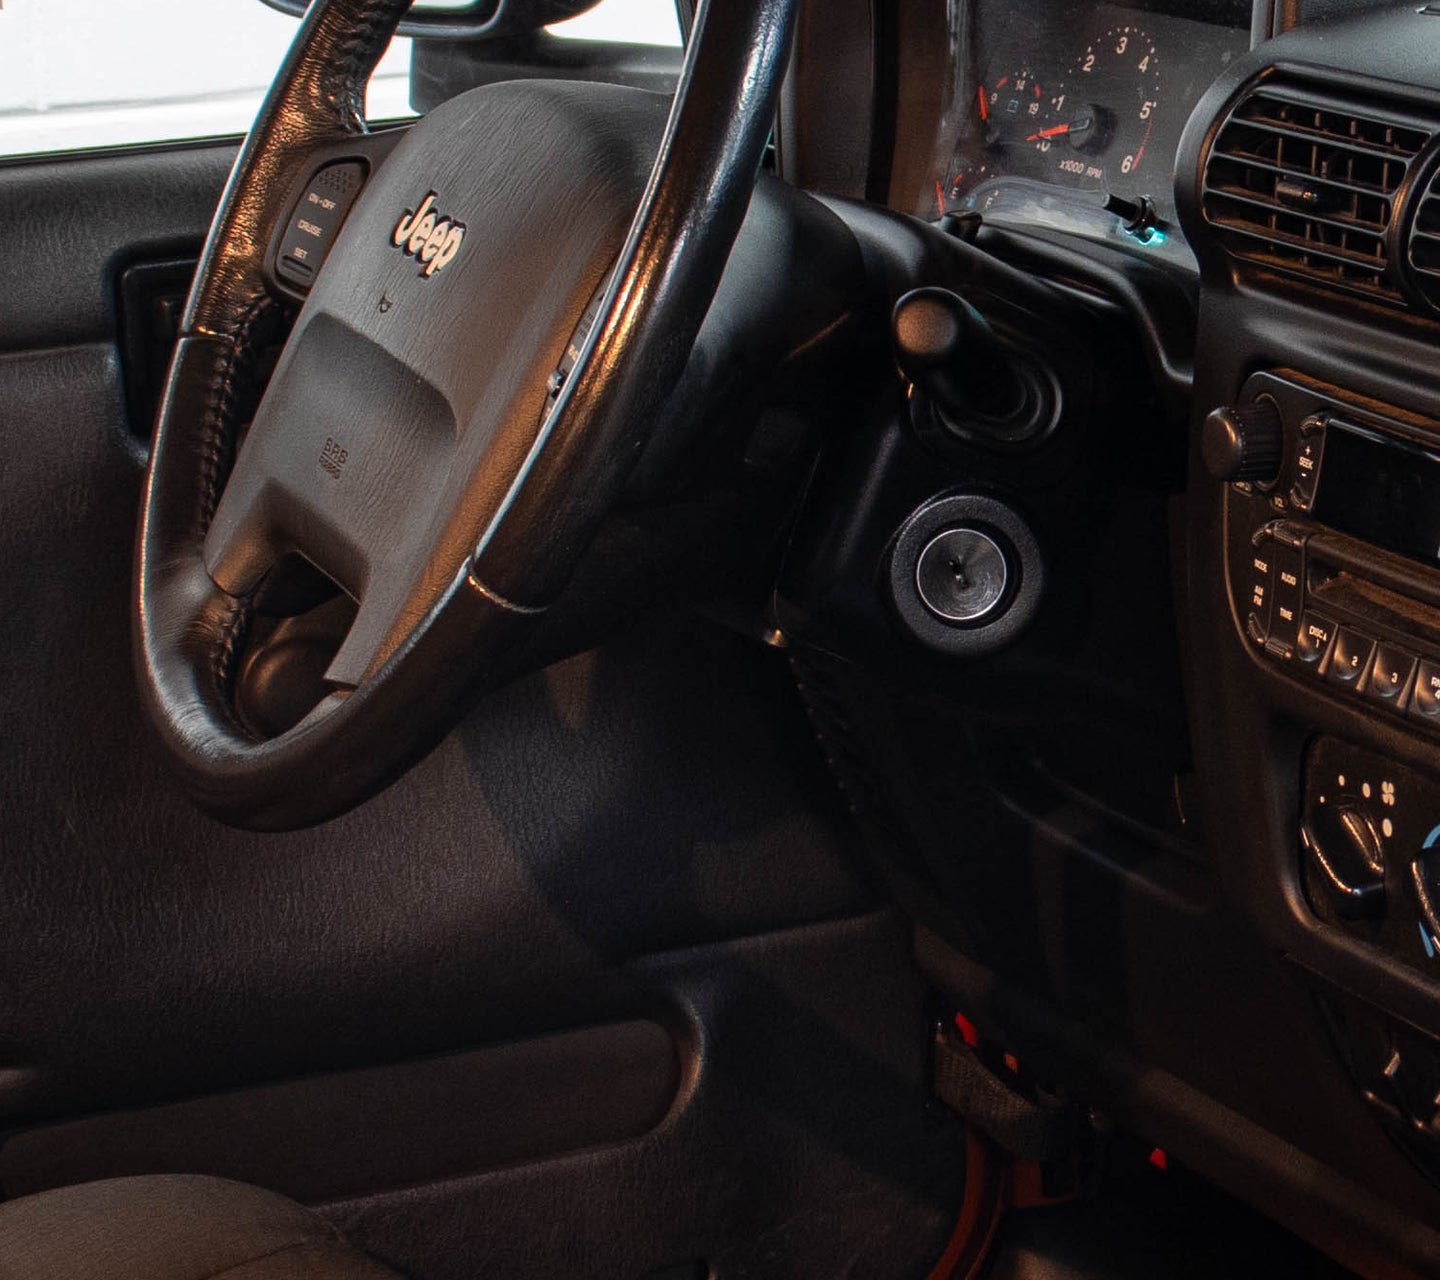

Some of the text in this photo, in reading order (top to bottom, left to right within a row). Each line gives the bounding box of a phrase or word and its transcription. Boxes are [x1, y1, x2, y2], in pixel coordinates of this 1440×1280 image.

[1116, 37, 1128, 55] 3
[1082, 54, 1095, 73] 2
[1138, 55, 1151, 73] 4
[1056, 94, 1066, 112] 1
[1139, 101, 1151, 120] 5
[1120, 154, 1133, 174] 6
[393, 193, 465, 276] Jeep
[293, 247, 308, 260] SET
[1298, 455, 1314, 471] SEEK
[1281, 572, 1297, 587] AUDIO
[1279, 607, 1293, 622] TIME
[1351, 655, 1359, 668] 2
[1391, 671, 1398, 684] 3
